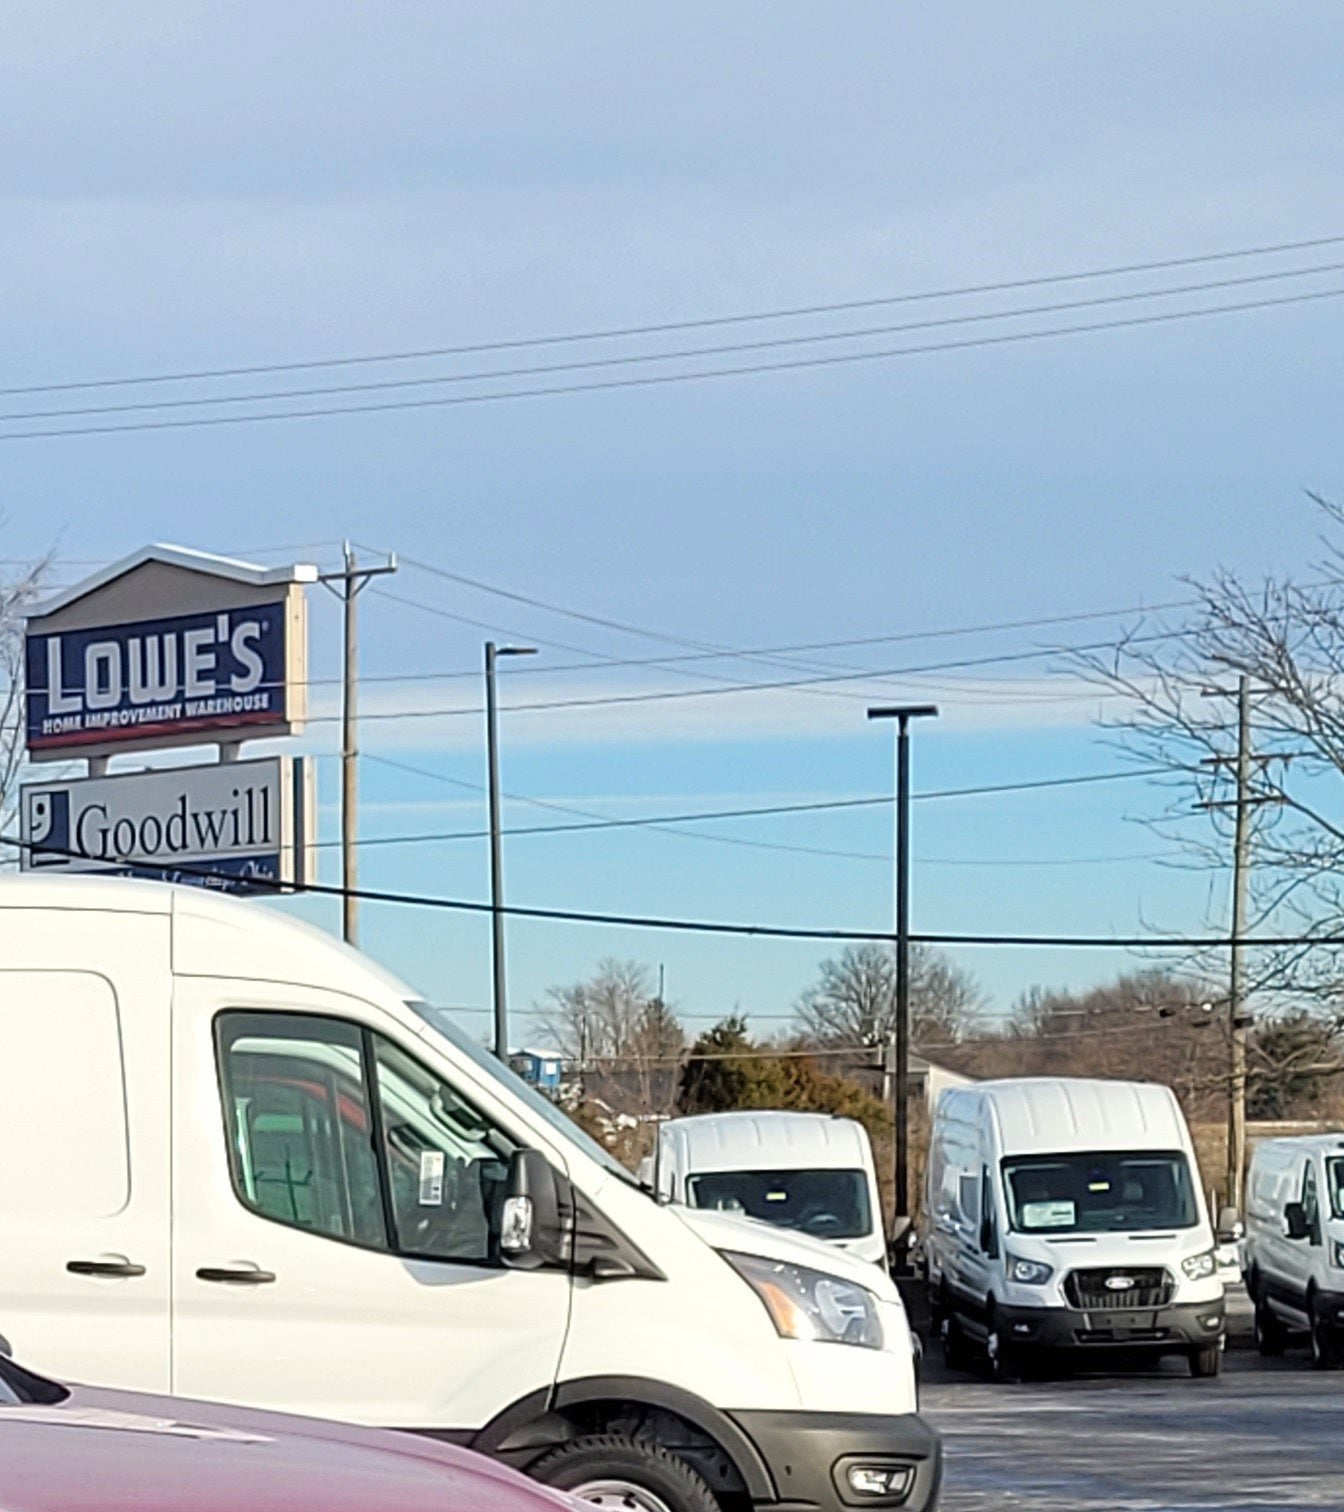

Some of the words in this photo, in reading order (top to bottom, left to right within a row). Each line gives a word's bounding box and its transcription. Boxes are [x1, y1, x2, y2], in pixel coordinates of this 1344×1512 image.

[46, 613, 264, 715] LOWE'S
[42, 714, 81, 735] HOME
[84, 703, 182, 729] IMPROVEMENT
[185, 692, 269, 717] WAREHOUSE
[75, 784, 273, 859] Goodwill
